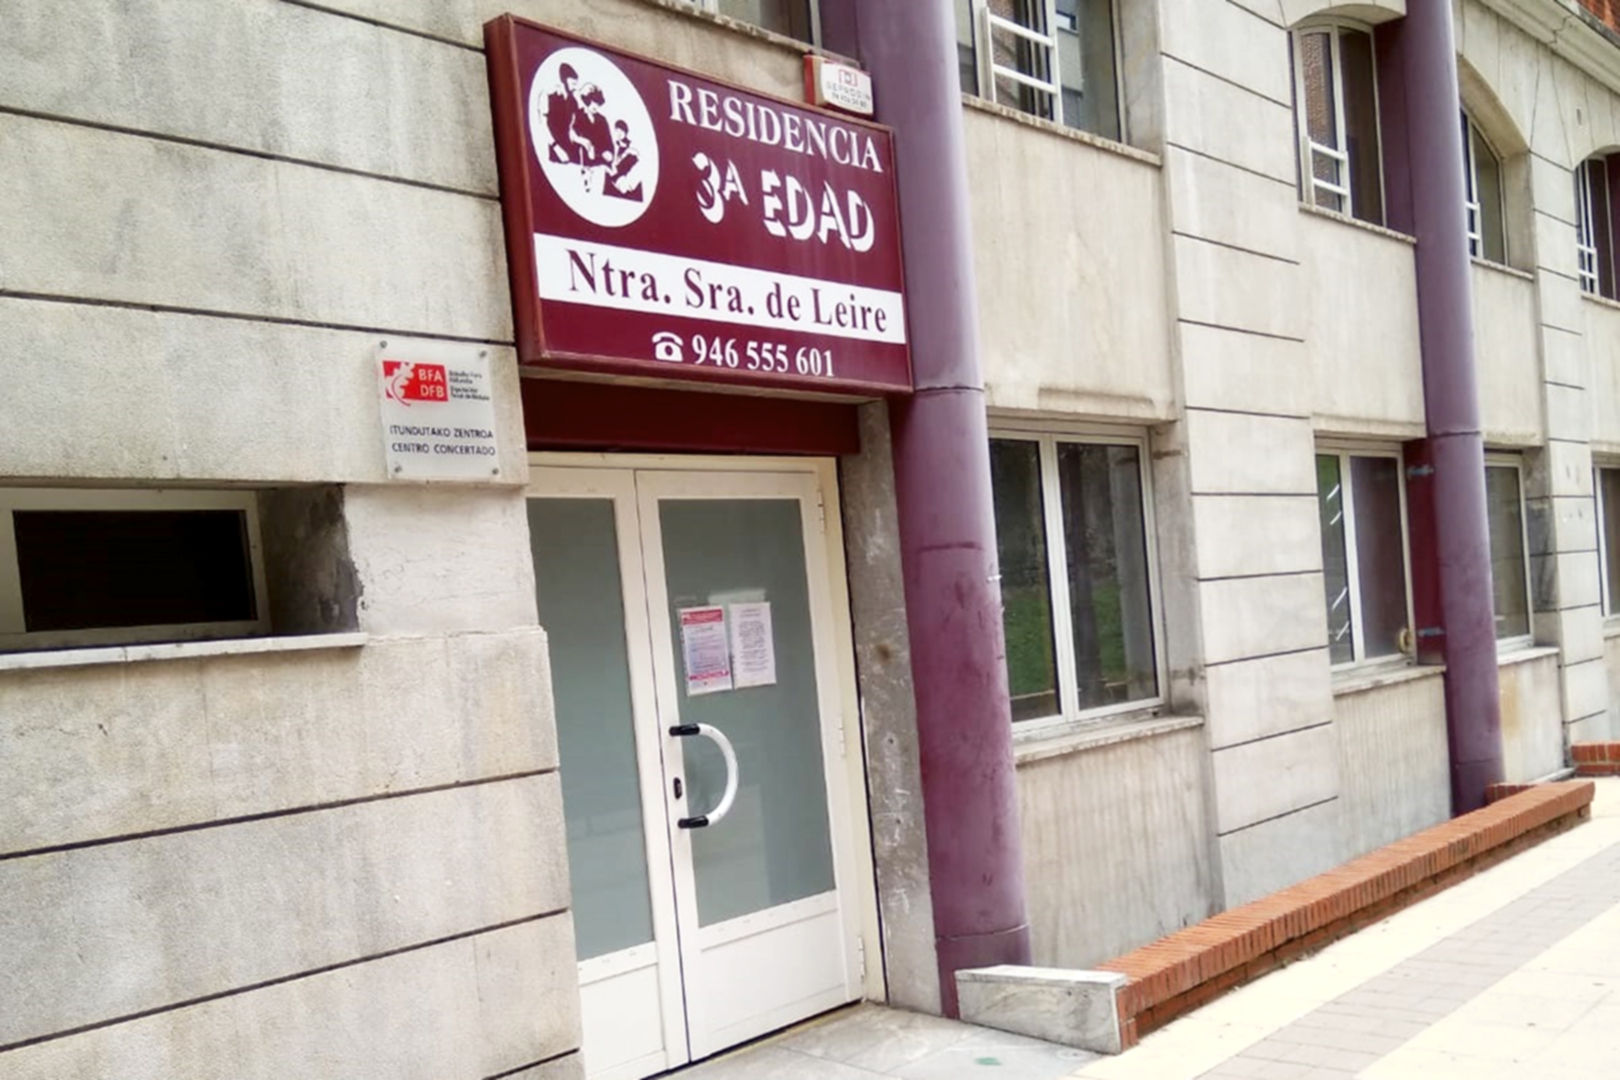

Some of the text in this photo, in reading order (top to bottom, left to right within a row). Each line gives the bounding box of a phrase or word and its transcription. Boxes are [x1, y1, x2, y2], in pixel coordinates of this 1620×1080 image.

[667, 79, 883, 173] RESIDENCIA
[761, 167, 875, 253] EDAD
[567, 249, 888, 333] Ntra. Sra. de Leire
[690, 335, 834, 378] 946 555 601
[418, 369, 443, 383] BFA
[421, 386, 444, 397] DFB
[390, 424, 493, 438] ITUNDUTAKO ZENTROA
[392, 443, 496, 456] CENTRO CONCERTADO
